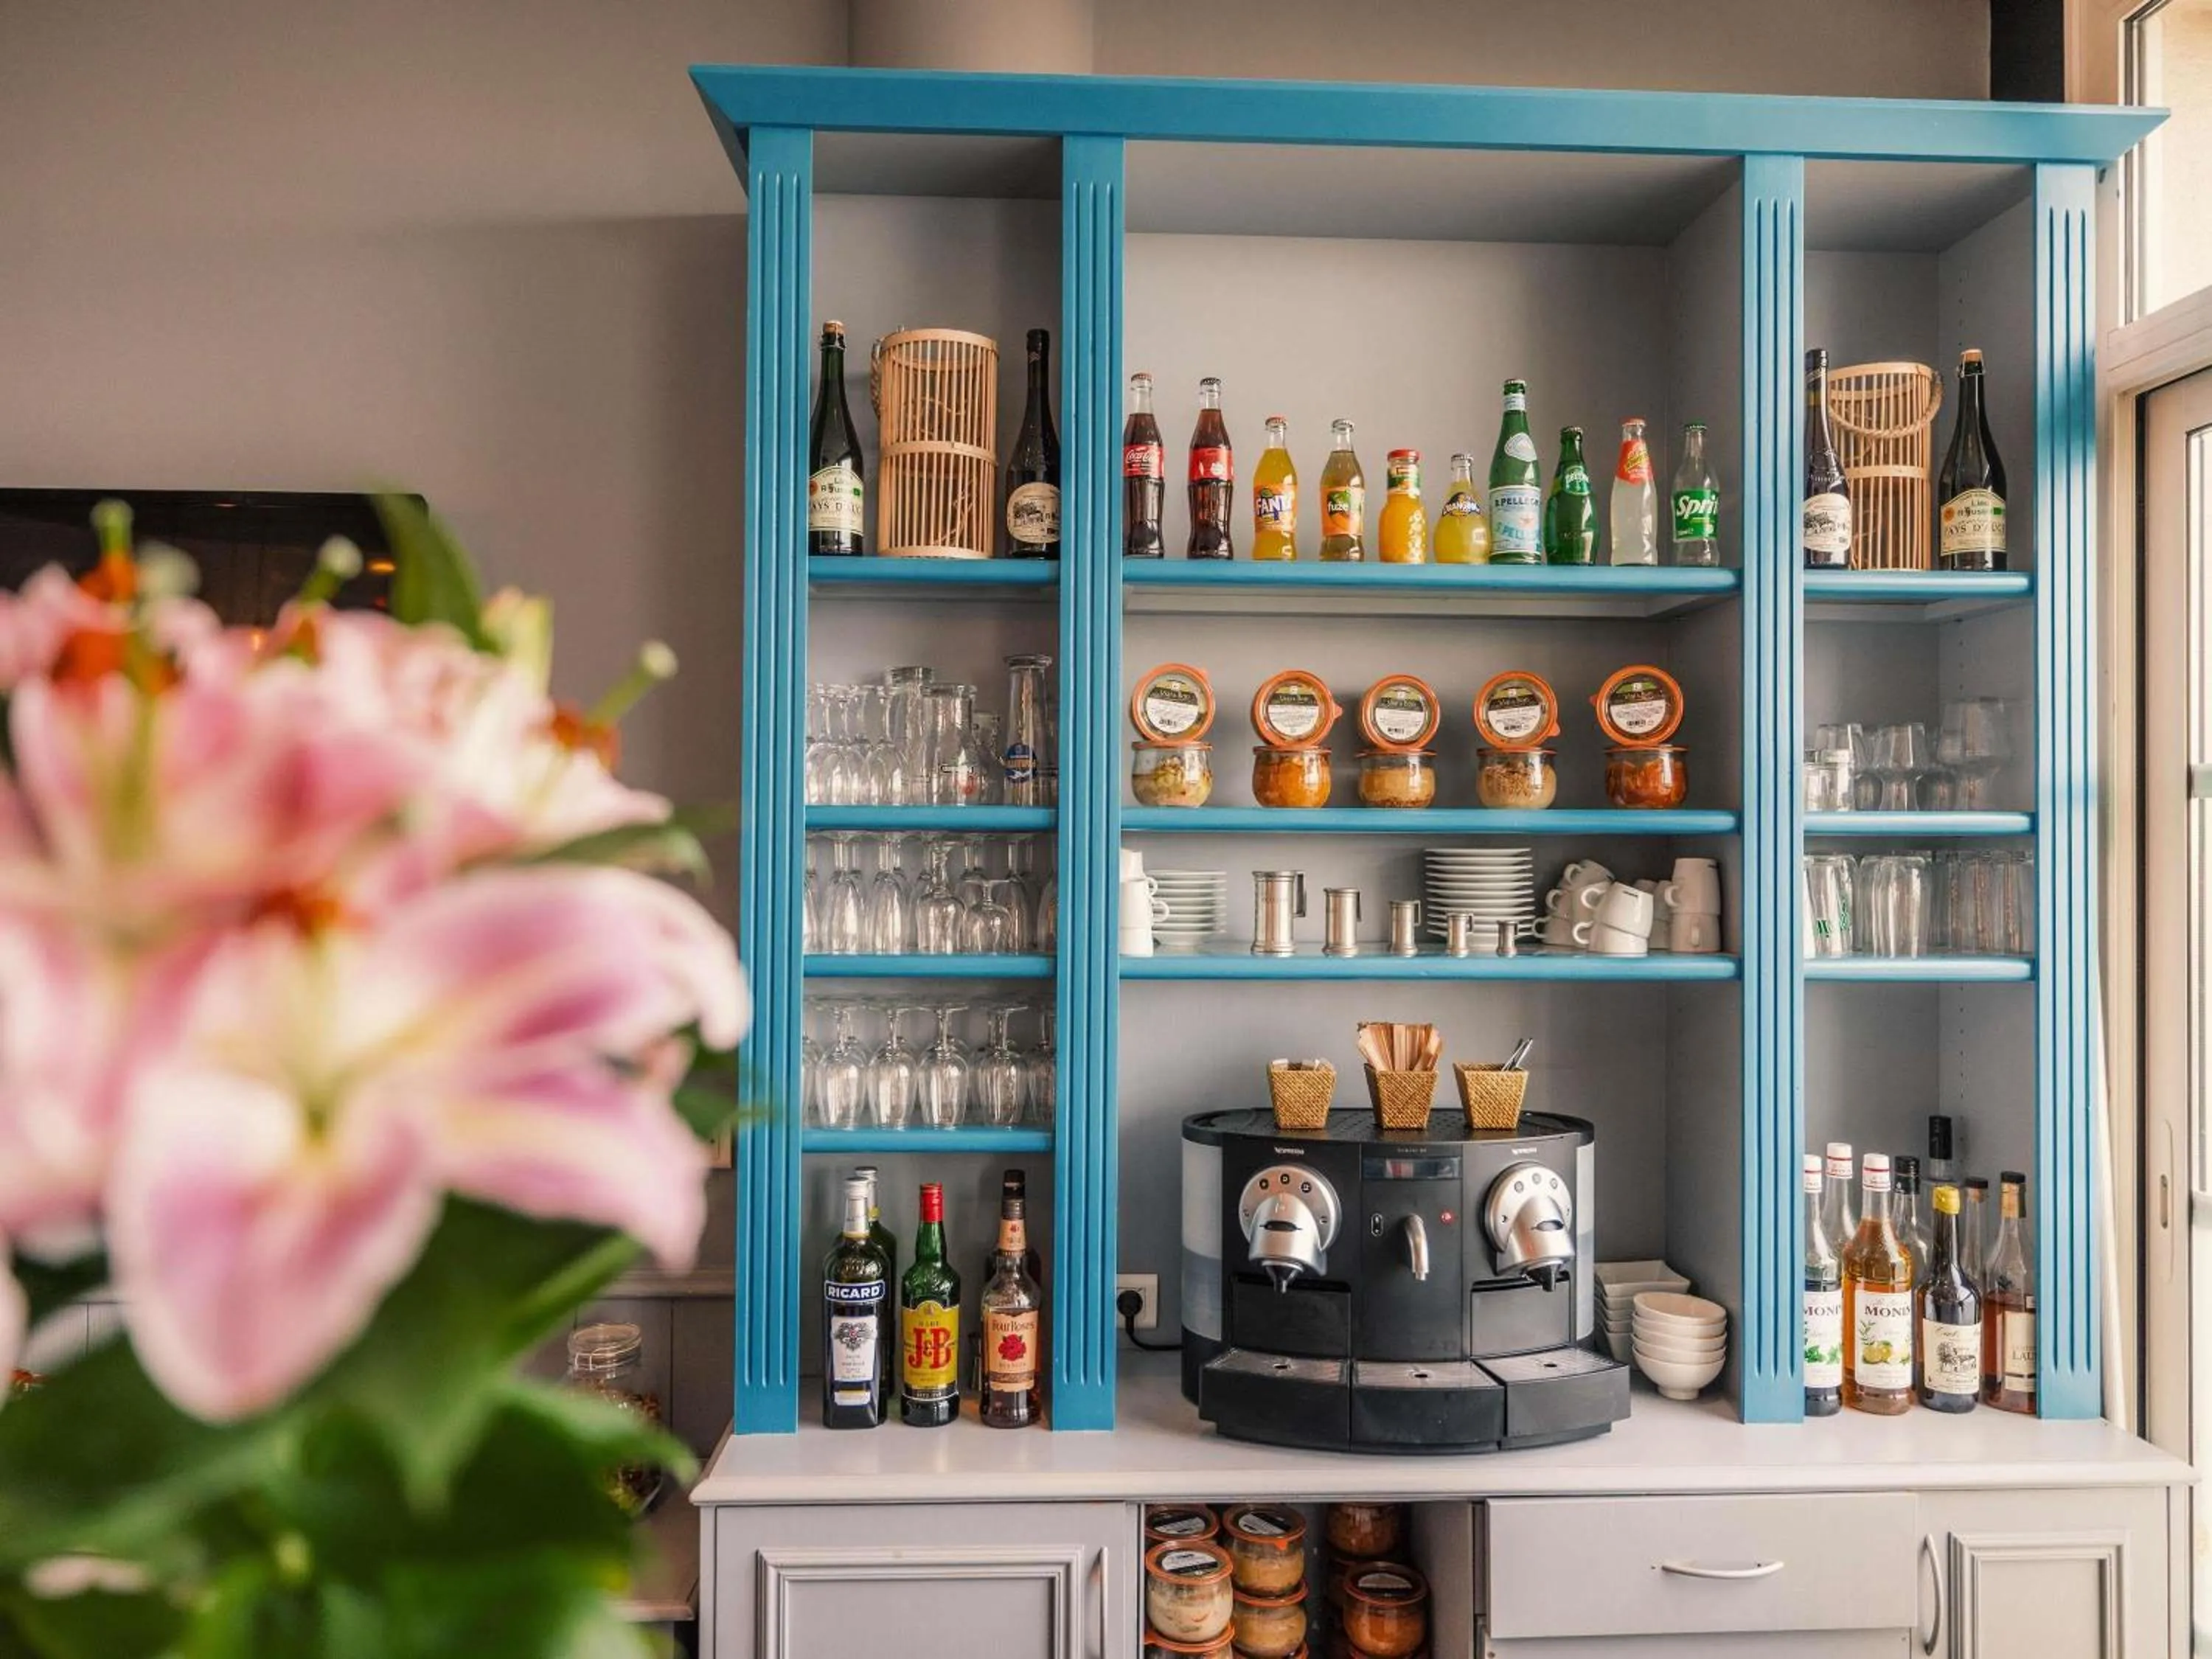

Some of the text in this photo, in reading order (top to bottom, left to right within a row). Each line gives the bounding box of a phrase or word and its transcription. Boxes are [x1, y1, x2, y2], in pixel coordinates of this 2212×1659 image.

[1676, 495, 1719, 520] Sprit
[828, 1284, 880, 1298] RICARD
[908, 1327, 951, 1368] J&B
